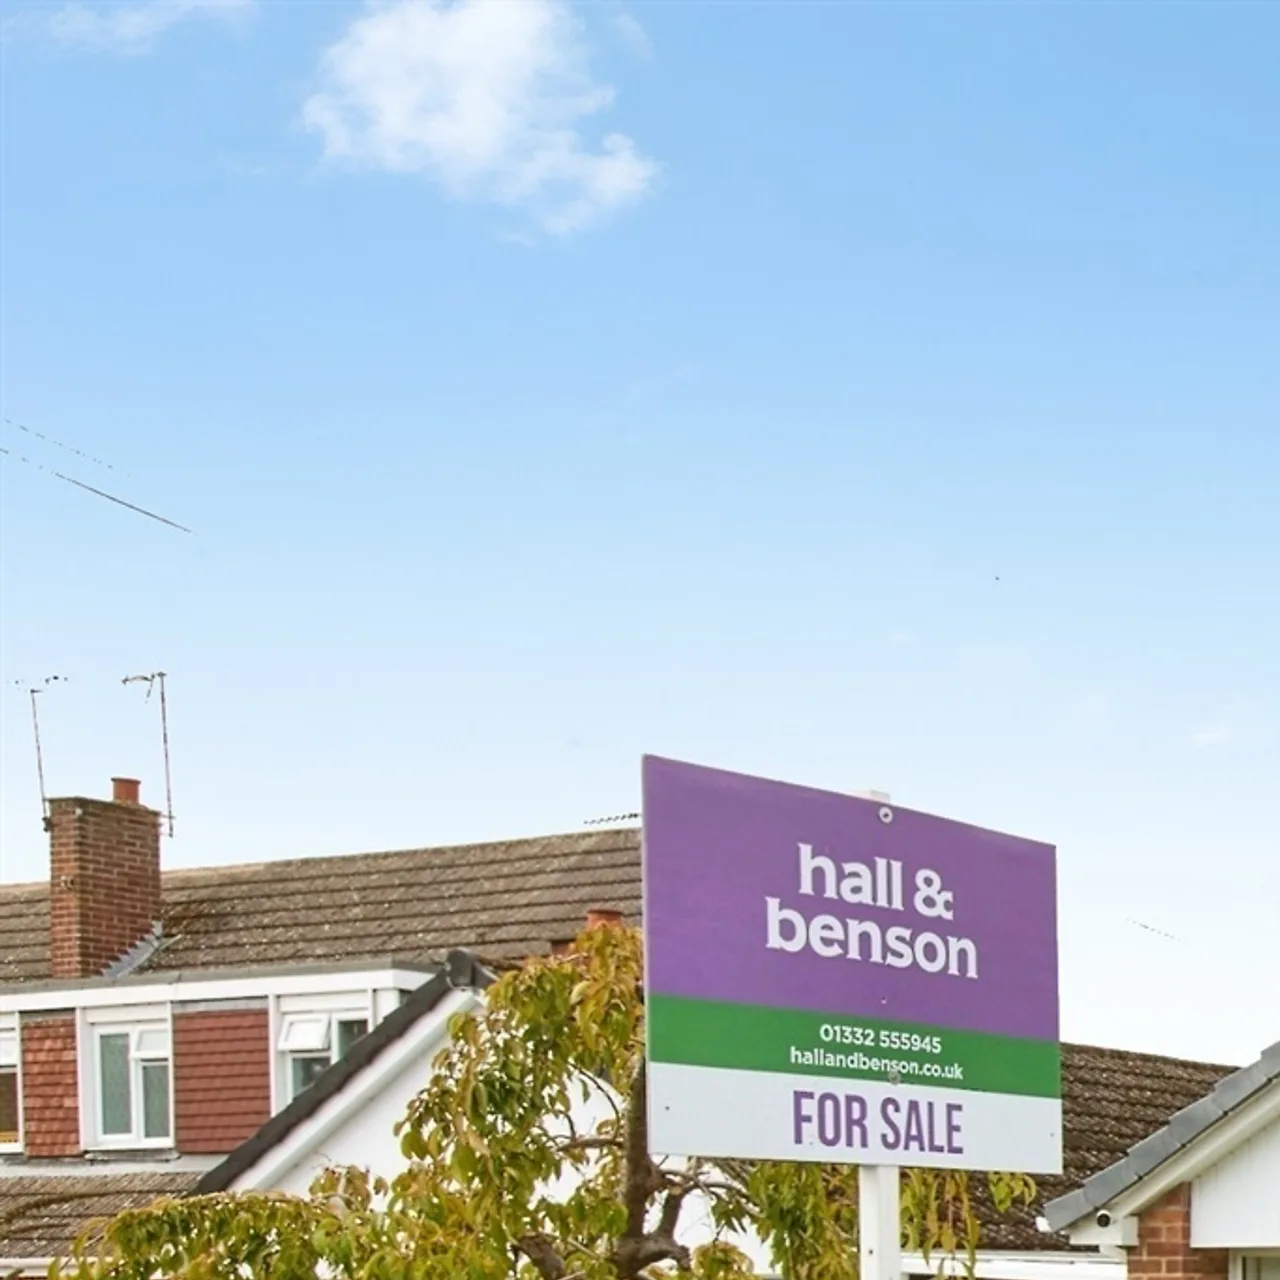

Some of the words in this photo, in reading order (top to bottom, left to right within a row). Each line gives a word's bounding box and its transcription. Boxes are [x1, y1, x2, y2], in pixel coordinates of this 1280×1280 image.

[798, 843, 903, 911] hall
[914, 869, 954, 920] &
[765, 897, 978, 979] benson
[789, 1046, 964, 1080] hallandbenson.co.uk
[819, 1023, 875, 1046] 01332
[879, 1030, 942, 1054] 555945
[793, 1090, 868, 1149] FOR
[880, 1096, 964, 1155] SALE
